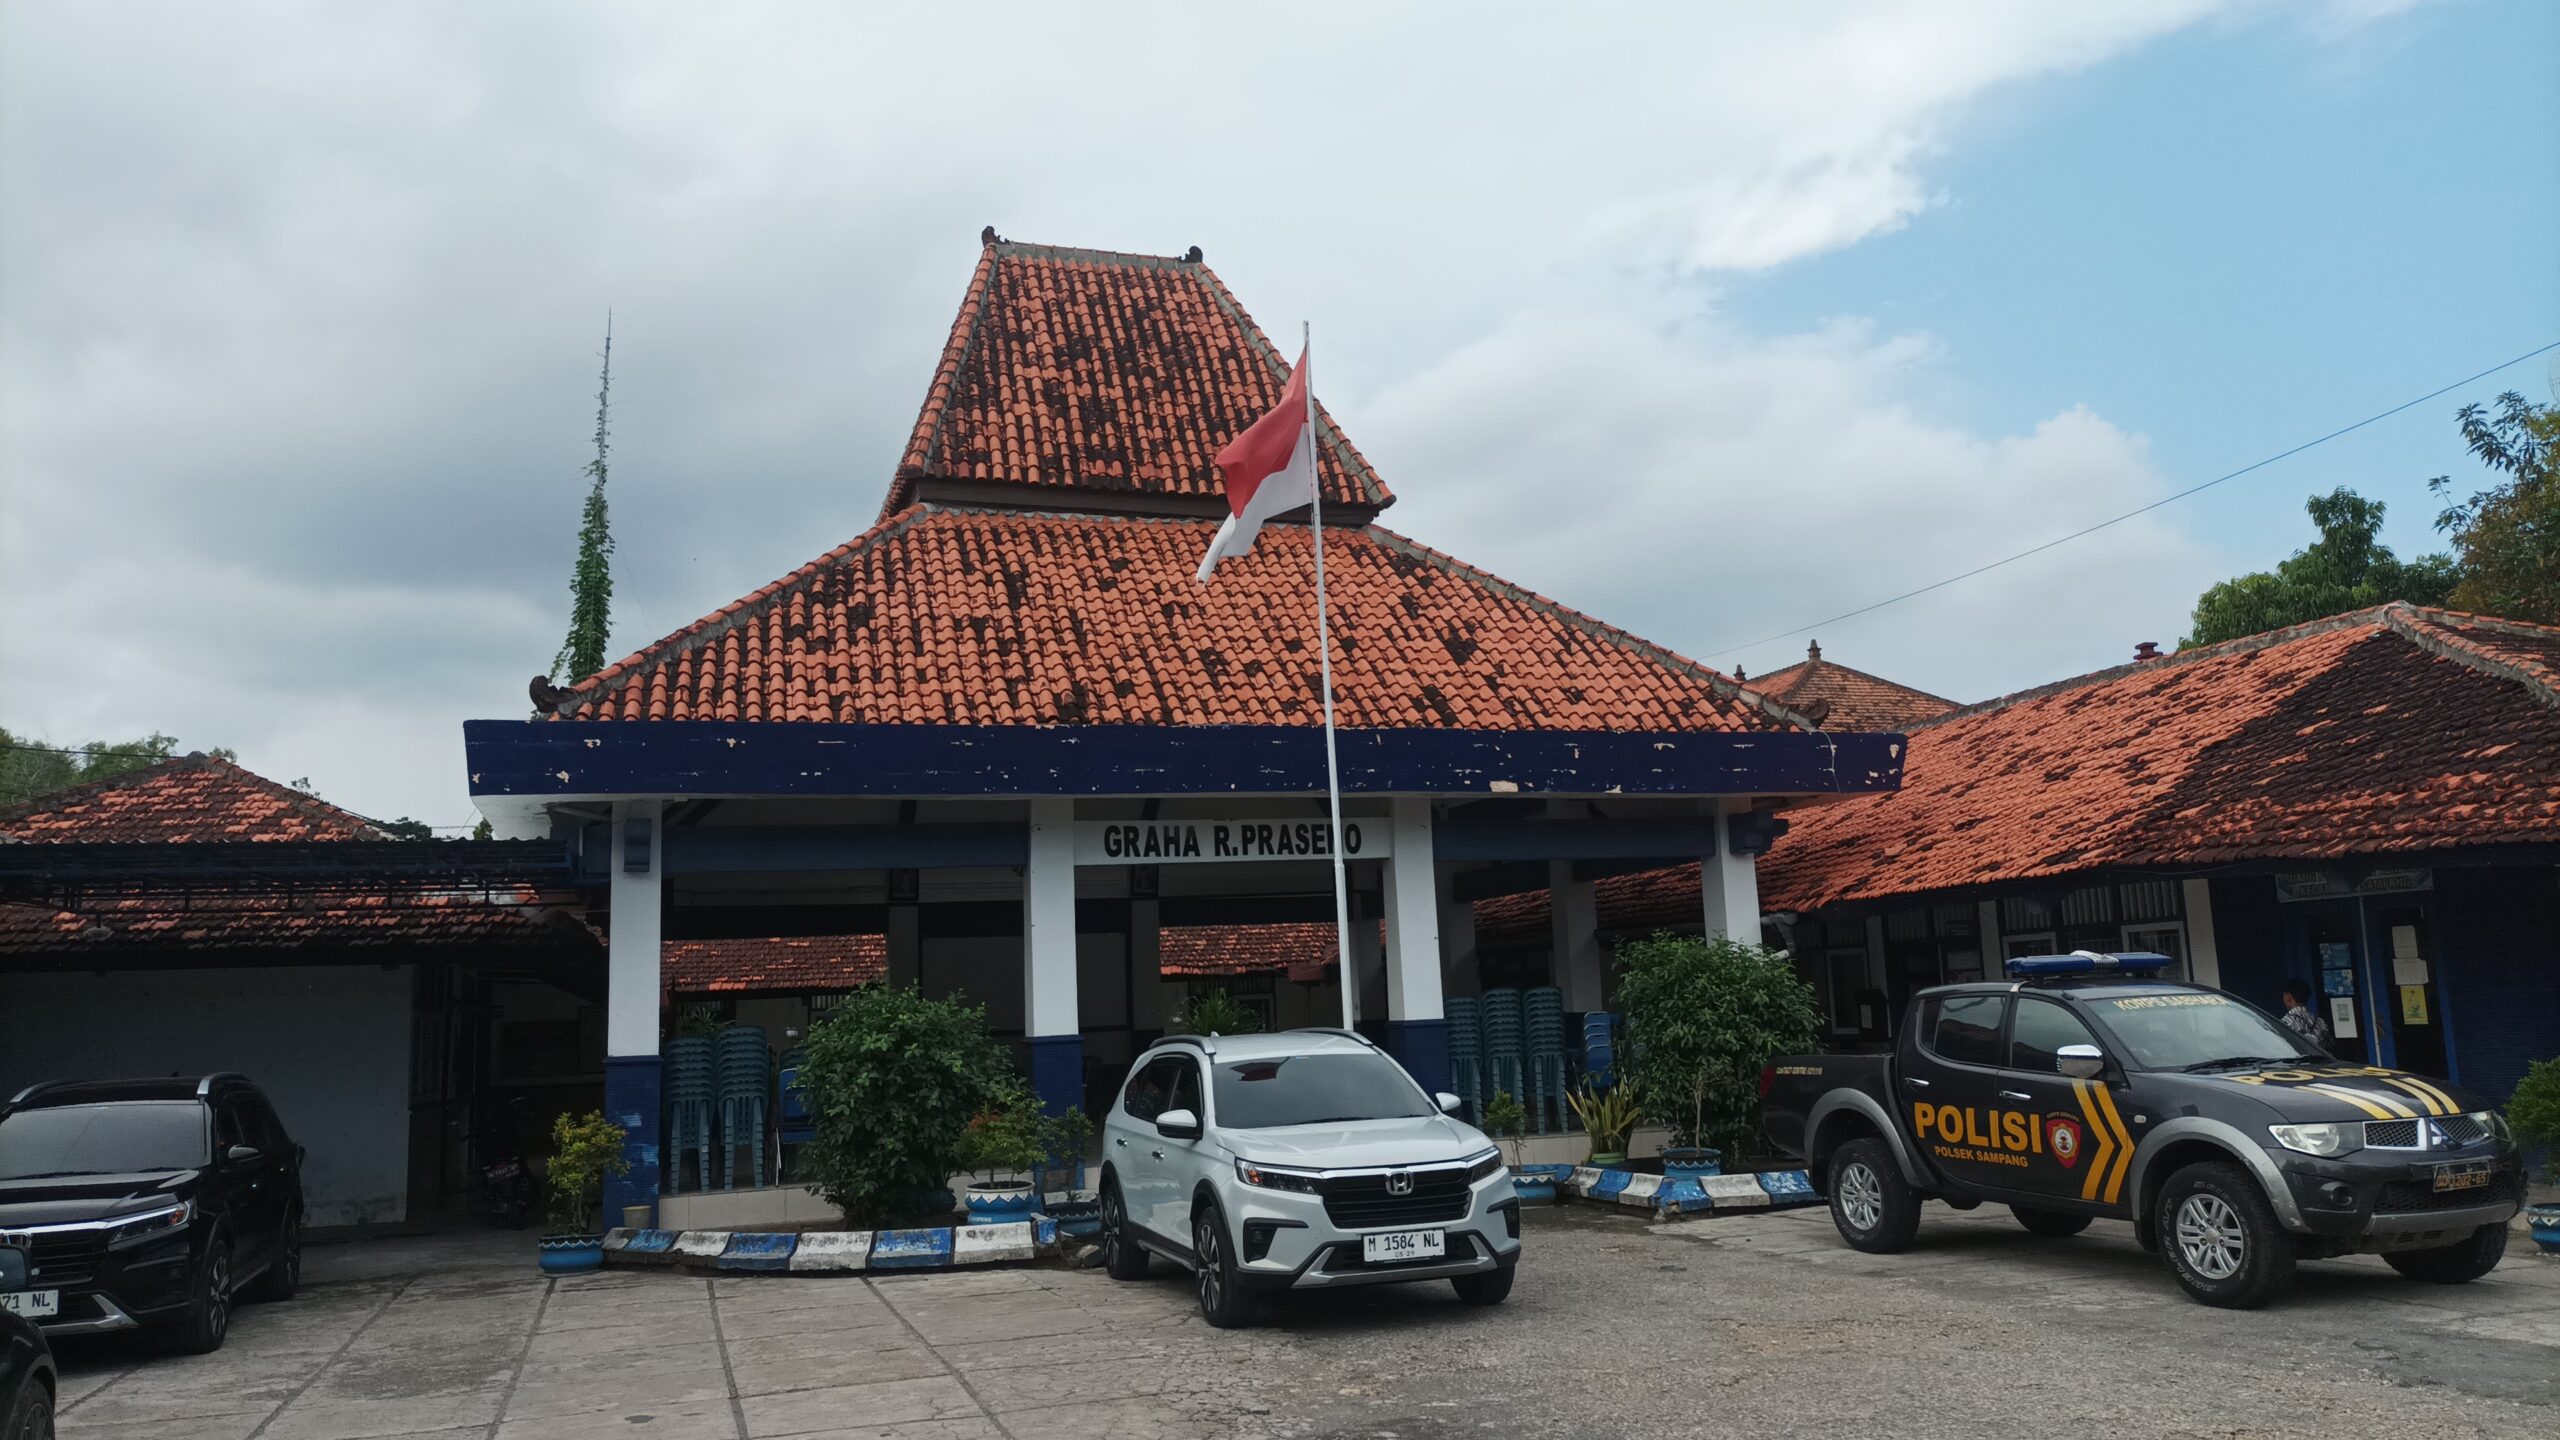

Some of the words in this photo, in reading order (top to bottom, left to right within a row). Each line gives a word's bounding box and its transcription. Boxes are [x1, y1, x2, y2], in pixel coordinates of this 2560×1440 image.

[1104, 824, 1200, 858] GRAHA
[1914, 1102, 2043, 1154] POLISI
[1934, 1145, 1974, 1161] POLSEK
[1976, 1151, 2029, 1168] SAMPANG
[1368, 1237, 1376, 1252] M
[1384, 1234, 1415, 1251] 1584
[1424, 1233, 1440, 1248] NL
[32, 1293, 50, 1307] NL
